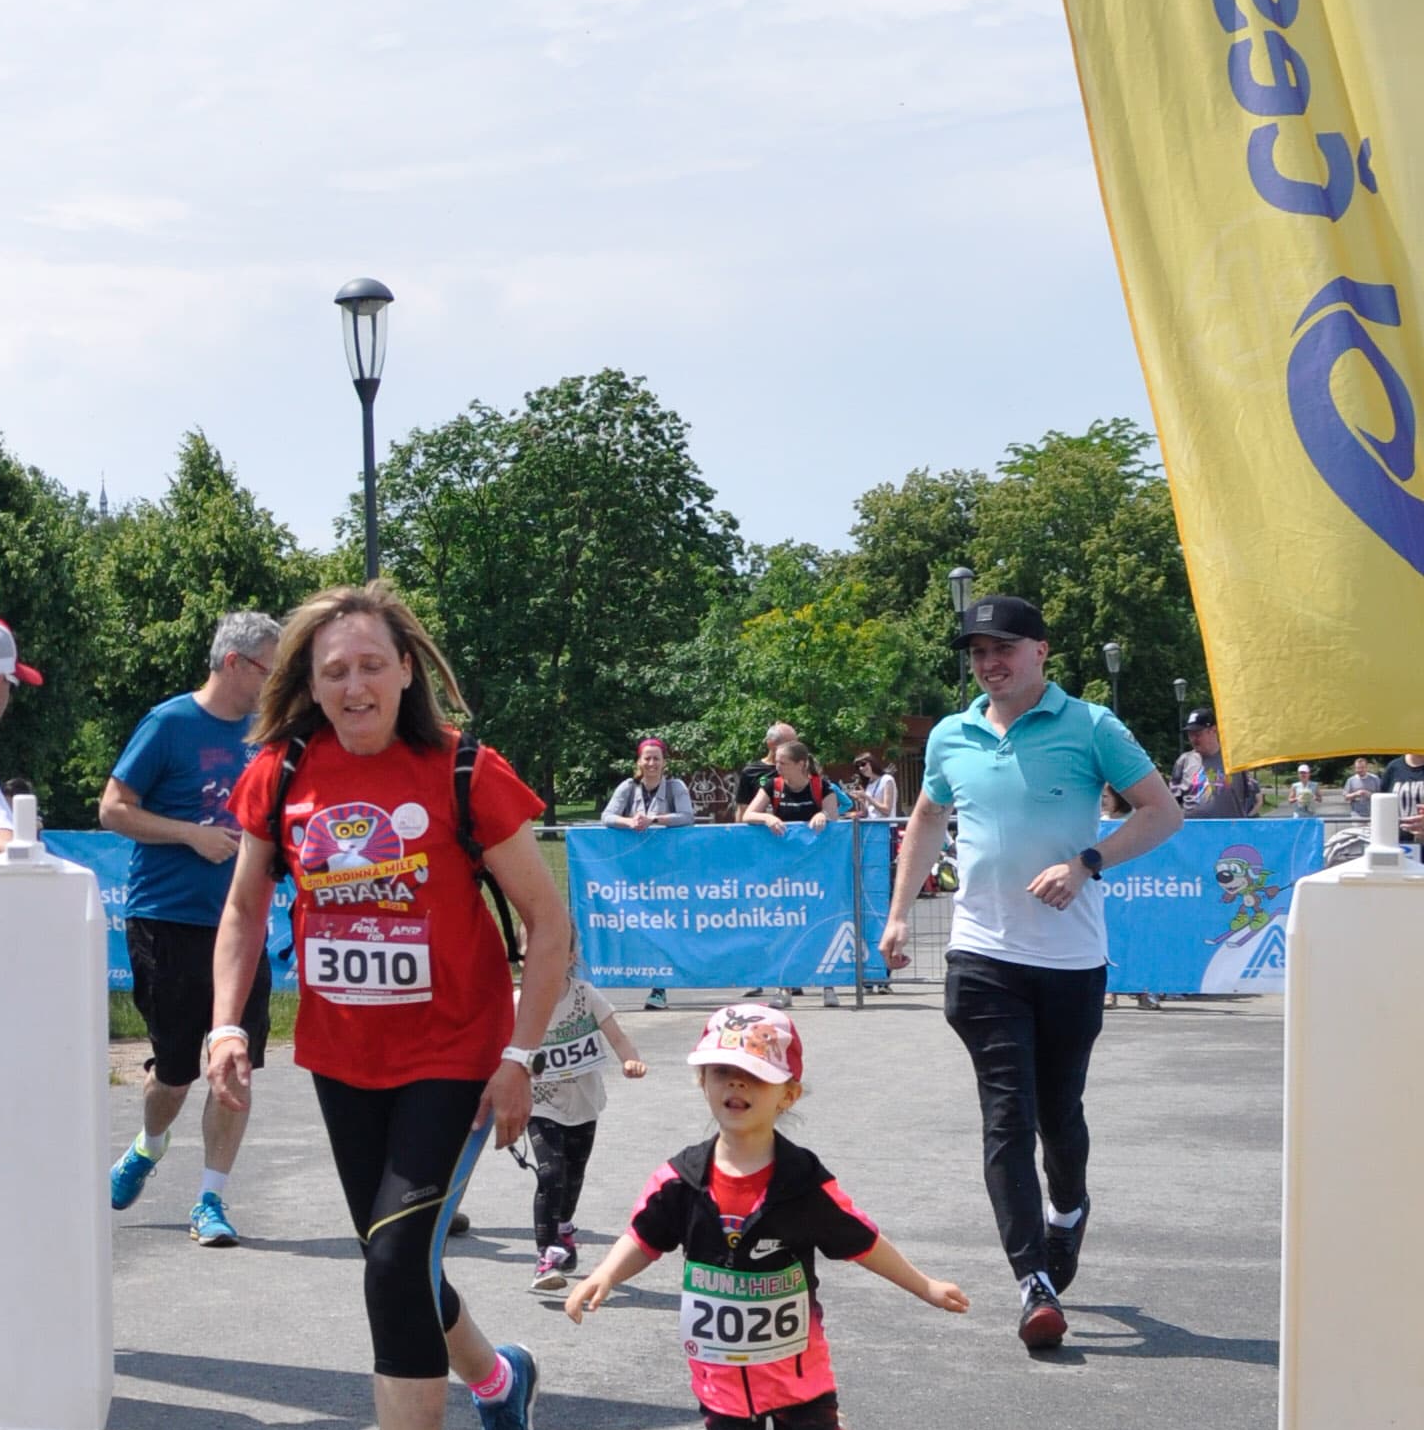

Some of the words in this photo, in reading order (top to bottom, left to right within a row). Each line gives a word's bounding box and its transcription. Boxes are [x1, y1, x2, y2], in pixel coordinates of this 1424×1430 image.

[586, 880, 689, 904] Pojistíme
[695, 879, 739, 899] vaši
[745, 877, 825, 899] rodinu,
[588, 908, 677, 932] majetek
[682, 908, 690, 929] i
[696, 905, 807, 933] podnikání
[317, 947, 419, 986] 3010
[591, 966, 674, 979] www.pvzp.cz
[691, 1267, 735, 1294] RUN
[749, 1269, 802, 1297] HELP
[691, 1300, 800, 1343] 2026
